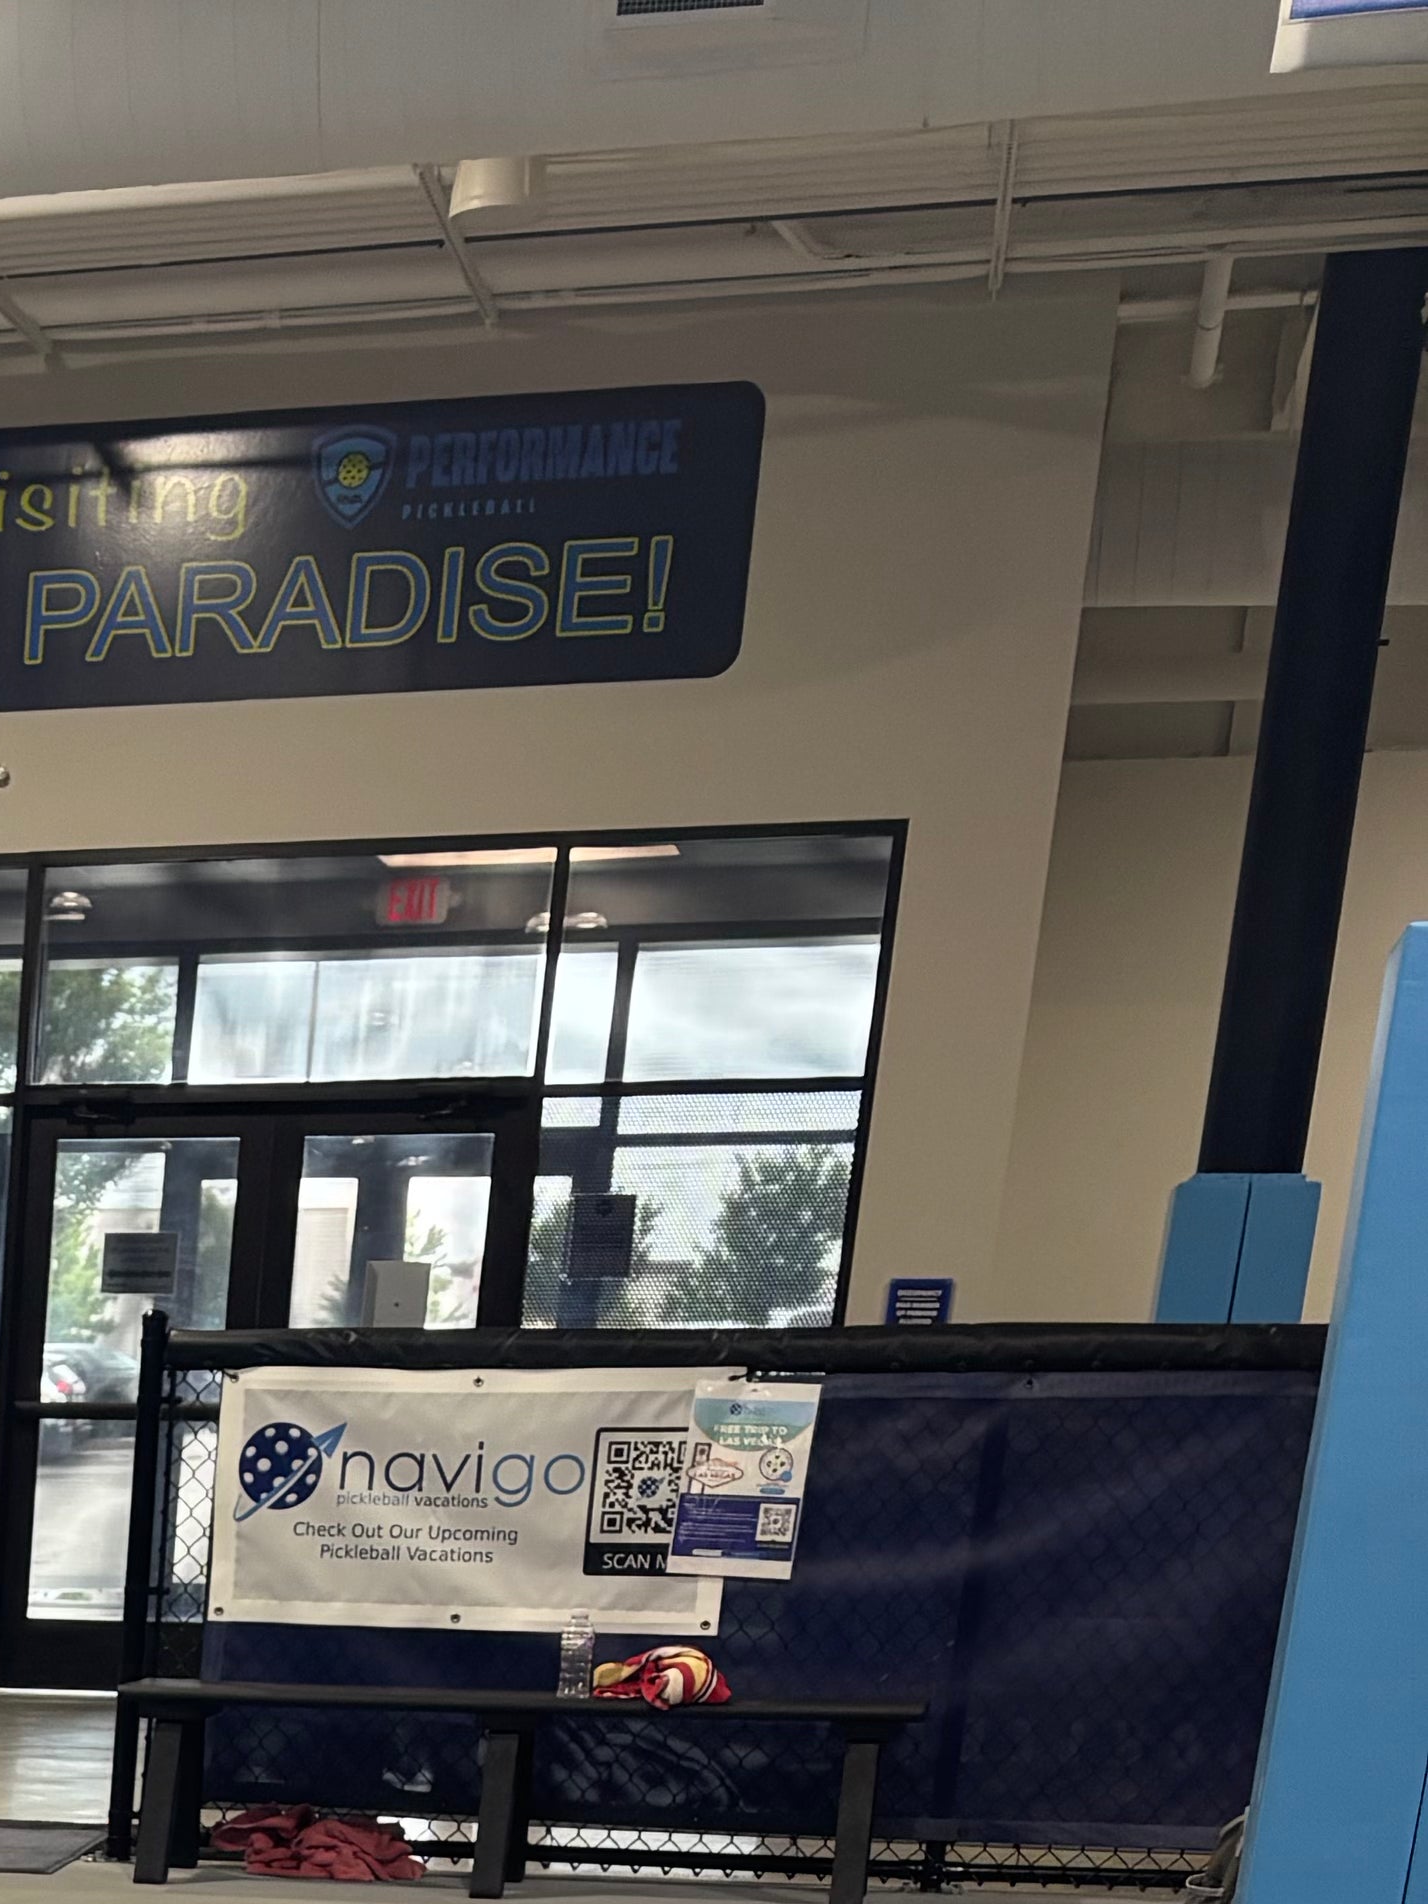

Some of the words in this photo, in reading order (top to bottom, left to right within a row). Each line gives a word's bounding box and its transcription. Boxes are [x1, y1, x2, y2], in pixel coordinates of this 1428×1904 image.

[405, 419, 681, 489] PERFORMANCE
[401, 499, 536, 521] PICKLEBALL
[23, 534, 674, 666] PARADISE!
[386, 875, 441, 922] EXIT
[772, 1425, 789, 1436] TO
[339, 1441, 586, 1507] navigo
[336, 1490, 410, 1508] pickleball
[414, 1493, 489, 1508] vacations
[293, 1521, 346, 1538] Check
[351, 1523, 383, 1540] Out
[389, 1524, 422, 1540] Our
[428, 1525, 519, 1546] Upcoming
[320, 1543, 401, 1561] Pickleball
[406, 1546, 494, 1563] Vacations
[602, 1553, 651, 1569] SCAN
